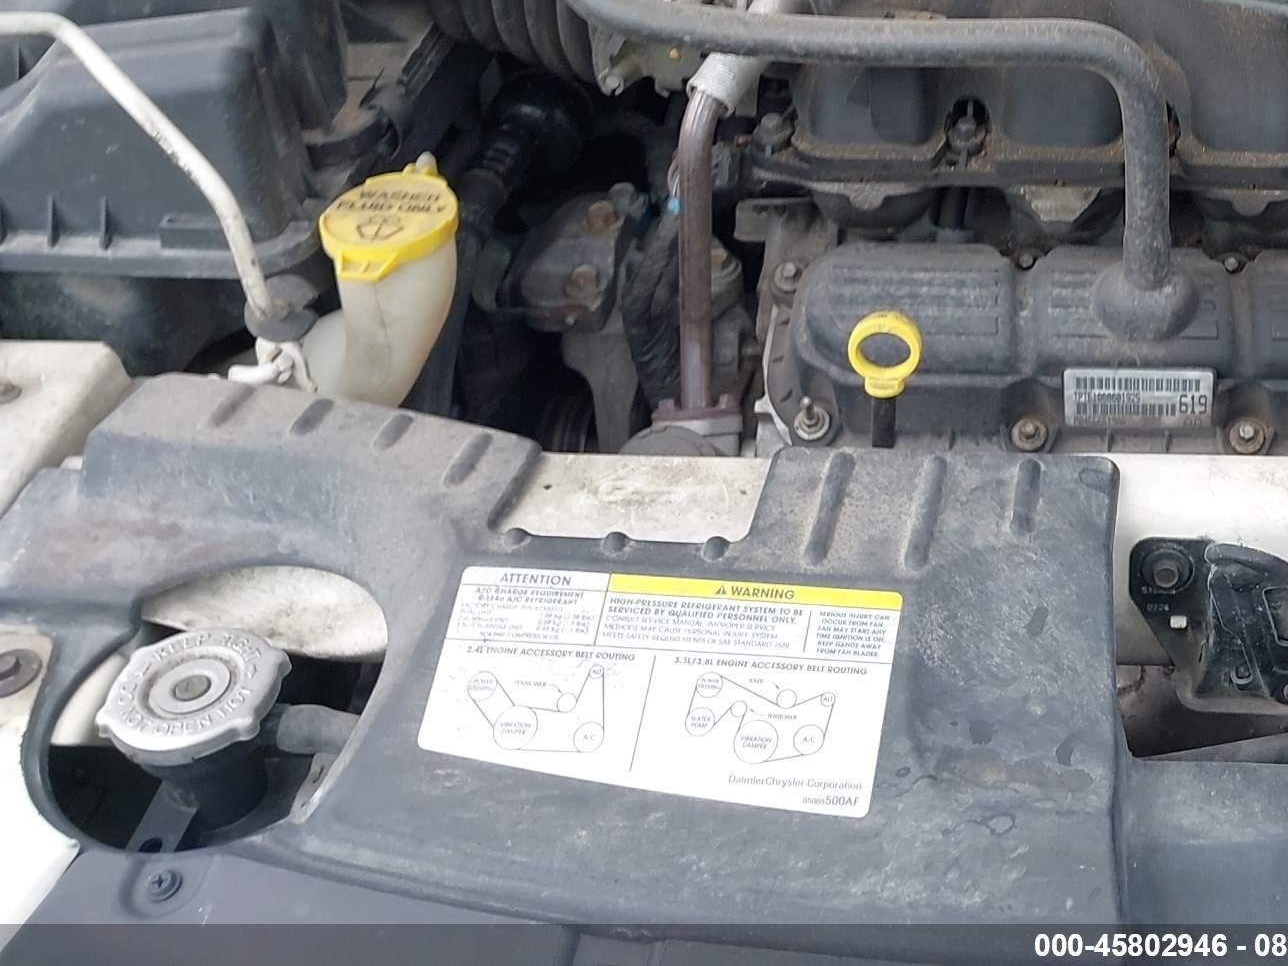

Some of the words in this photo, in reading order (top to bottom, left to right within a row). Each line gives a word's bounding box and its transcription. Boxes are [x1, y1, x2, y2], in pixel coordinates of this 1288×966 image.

[360, 190, 441, 201] WASHER
[1178, 394, 1208, 414] 619
[500, 572, 572, 586] ATTENTION
[530, 589, 585, 598] REQUIREMENT
[731, 586, 795, 600] WARNING
[525, 596, 578, 605] REFRIGERANT
[610, 598, 678, 609] HIGH-PRESSURE
[681, 601, 741, 613] REFRIGERANT
[743, 606, 776, 614] SYSTEM
[608, 606, 651, 615] SERVICED
[654, 608, 666, 616] BY
[668, 609, 714, 618] QUALIFIED
[716, 613, 768, 622] PERSONNEL
[641, 624, 656, 632] MAY
[486, 646, 518, 655] ENGINE
[520, 648, 573, 658] ACCESSORY
[575, 650, 593, 659] BELT
[596, 651, 636, 661] ROUTING
[716, 658, 749, 668] ENGINE
[751, 660, 804, 671] ACCESSORY
[806, 664, 825, 673] BELT
[827, 665, 868, 675] ROUTING
[154, 712, 213, 735] OPEN
[740, 735, 772, 744] VIBRATION
[742, 742, 767, 750] DAMPER
[728, 774, 806, 789] DaimlerChrysler
[807, 778, 862, 790] Corporation
